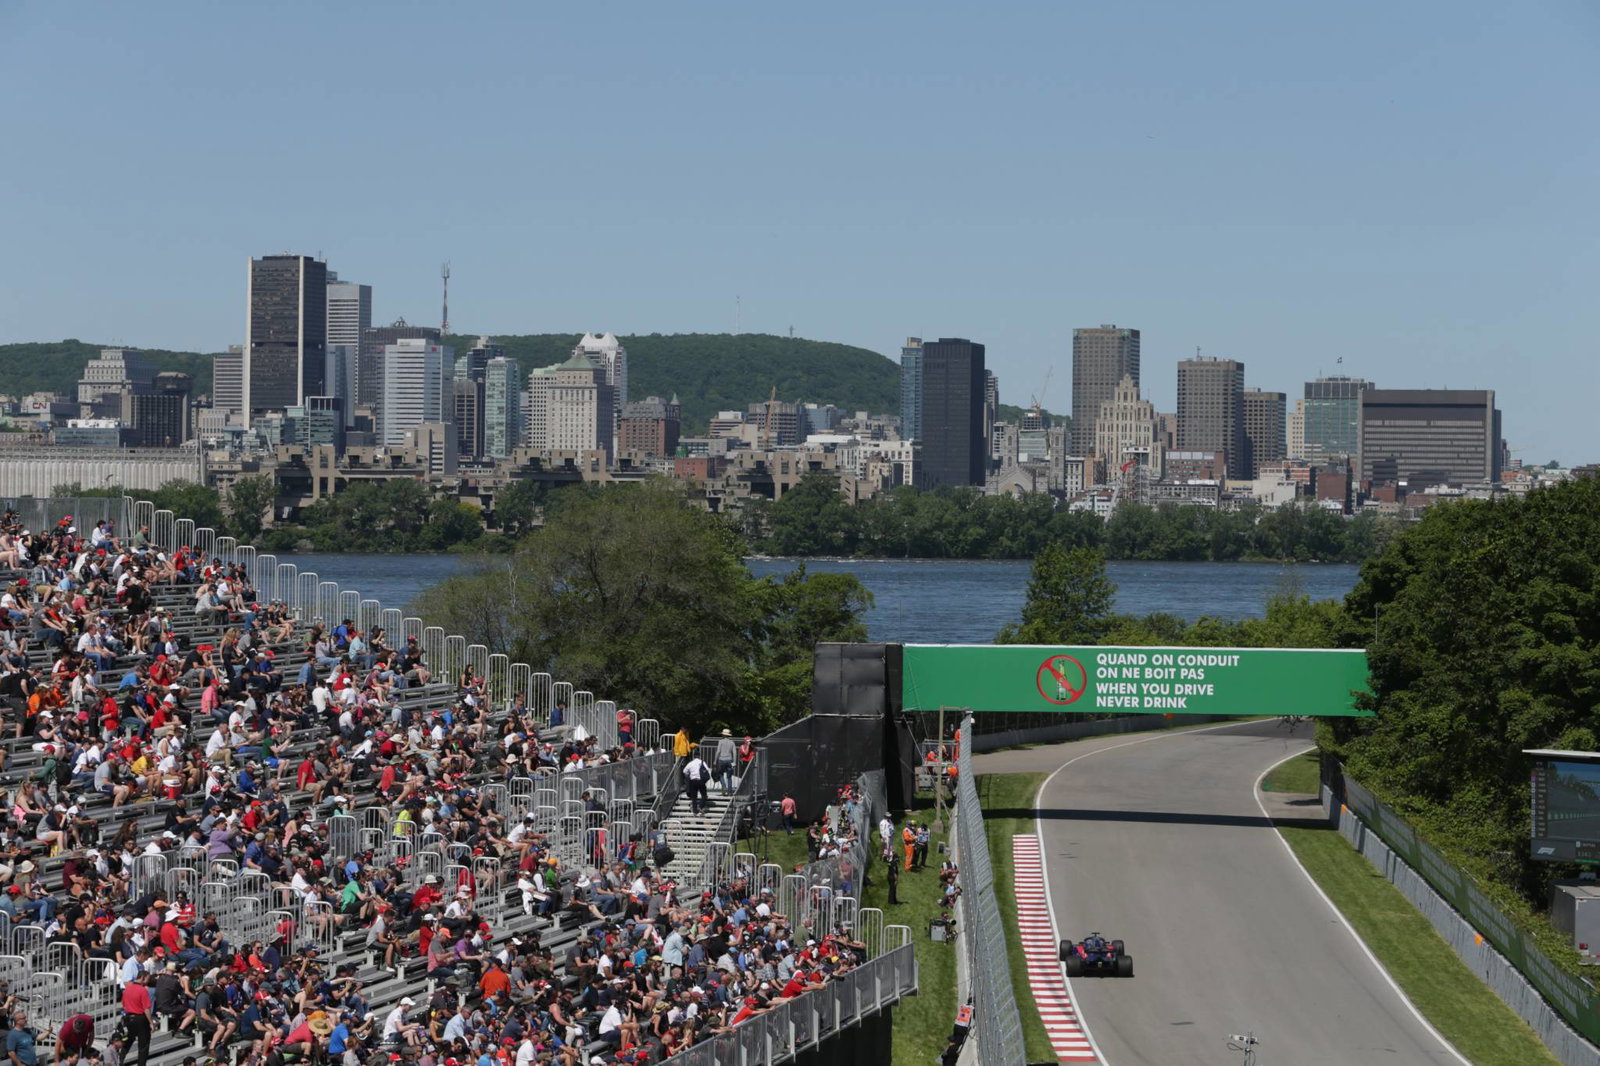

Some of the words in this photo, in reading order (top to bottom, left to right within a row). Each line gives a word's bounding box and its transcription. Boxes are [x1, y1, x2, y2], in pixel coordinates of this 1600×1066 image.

[1096, 653, 1148, 666] QUAND
[1151, 654, 1174, 666] ON
[1177, 654, 1240, 667] CONDUIT
[1096, 667, 1118, 679] ON
[1122, 667, 1140, 679] NE
[1144, 668, 1176, 679] BOIT
[1180, 668, 1205, 680] PAS
[1096, 682, 1137, 694] WHEN
[1140, 683, 1170, 695] YOU
[1174, 684, 1214, 696] DRIVE
[1096, 696, 1140, 708] NEVER
[1143, 697, 1187, 708] DRINK
